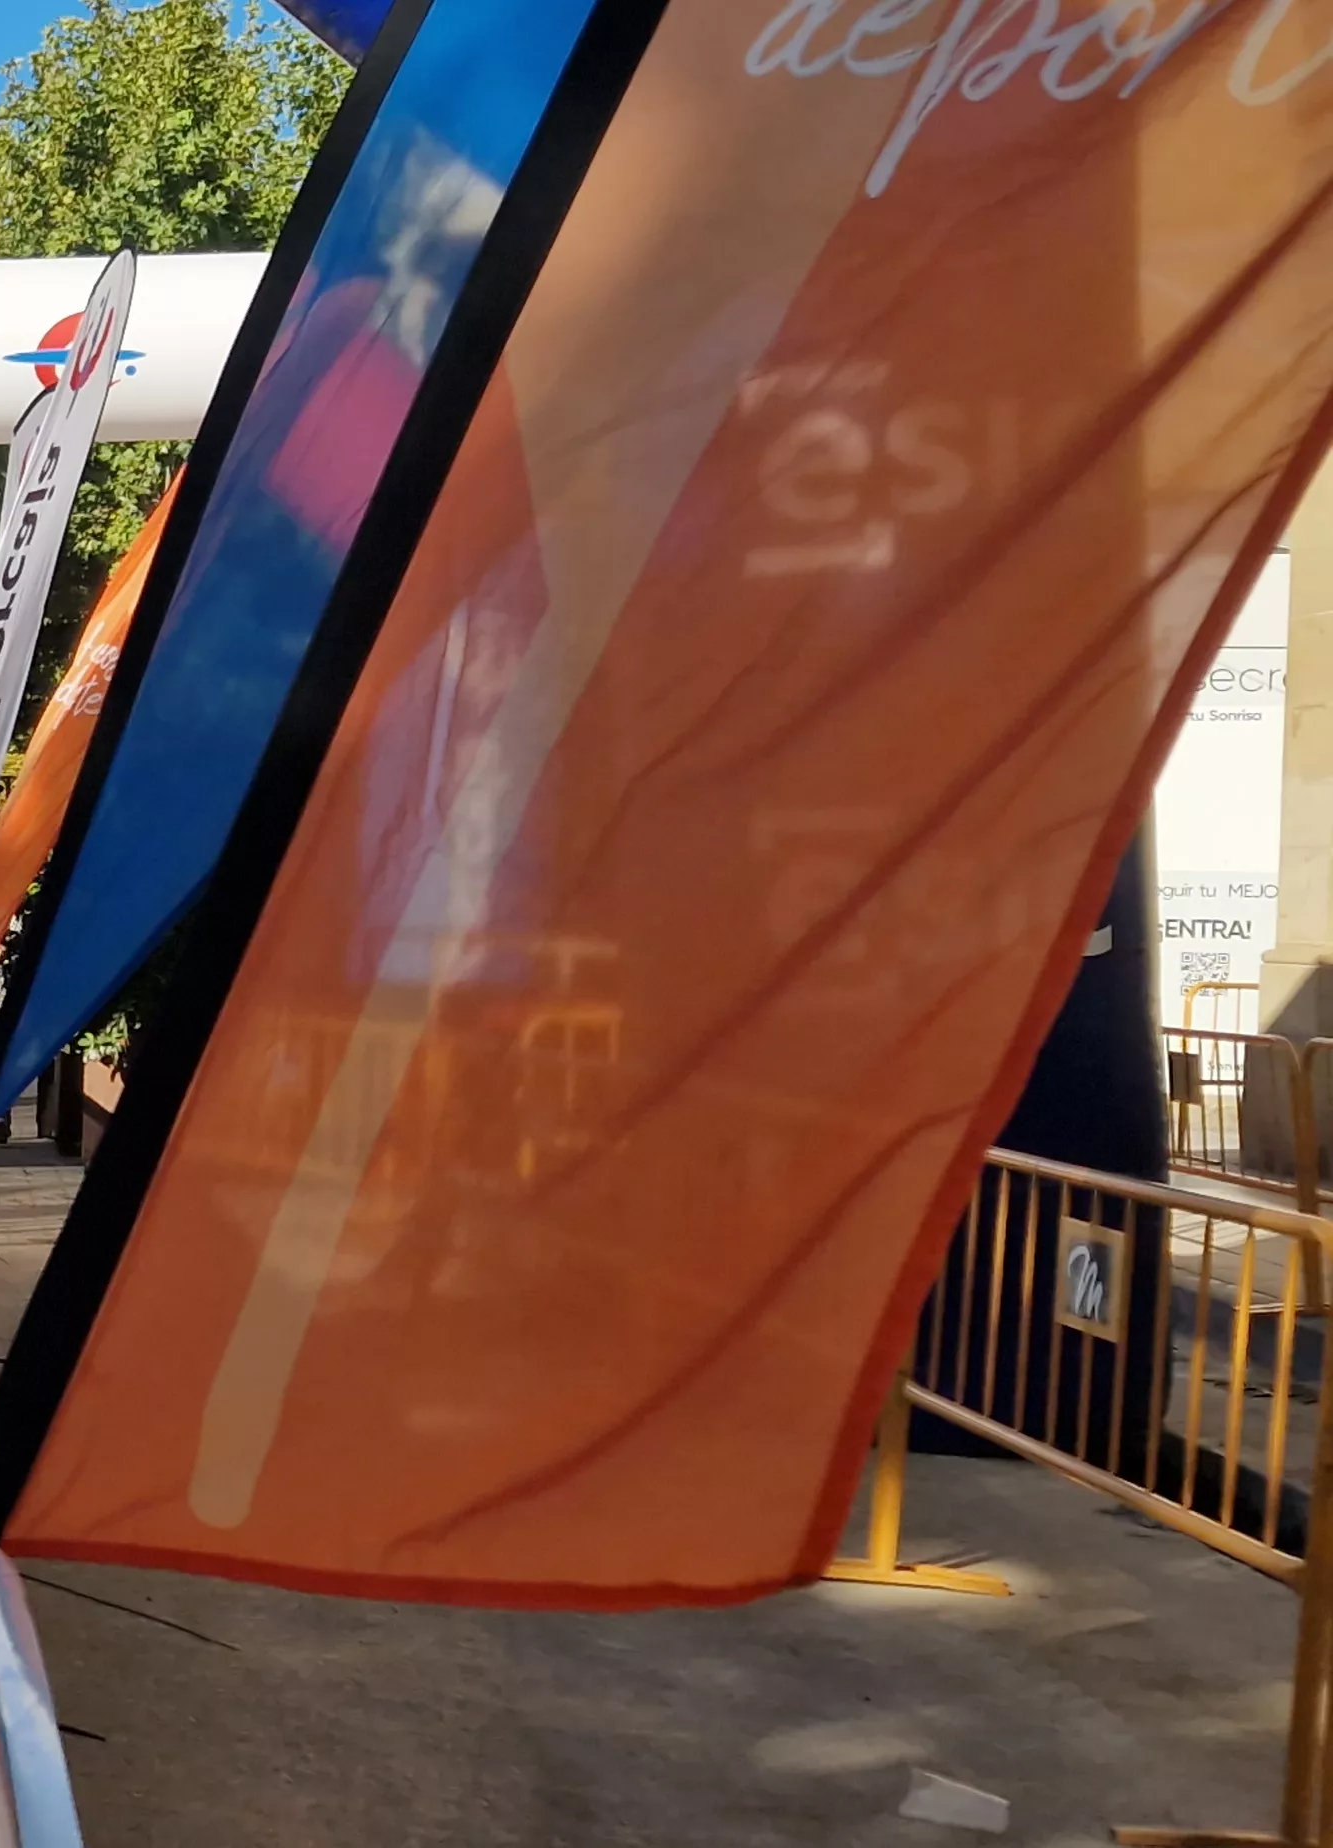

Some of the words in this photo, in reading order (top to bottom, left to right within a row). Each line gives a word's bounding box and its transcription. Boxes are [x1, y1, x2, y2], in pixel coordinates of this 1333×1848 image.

[1209, 709, 1263, 722] Sonrisa
[1200, 883, 1218, 898] tu
[1228, 883, 1281, 899] MEJO
